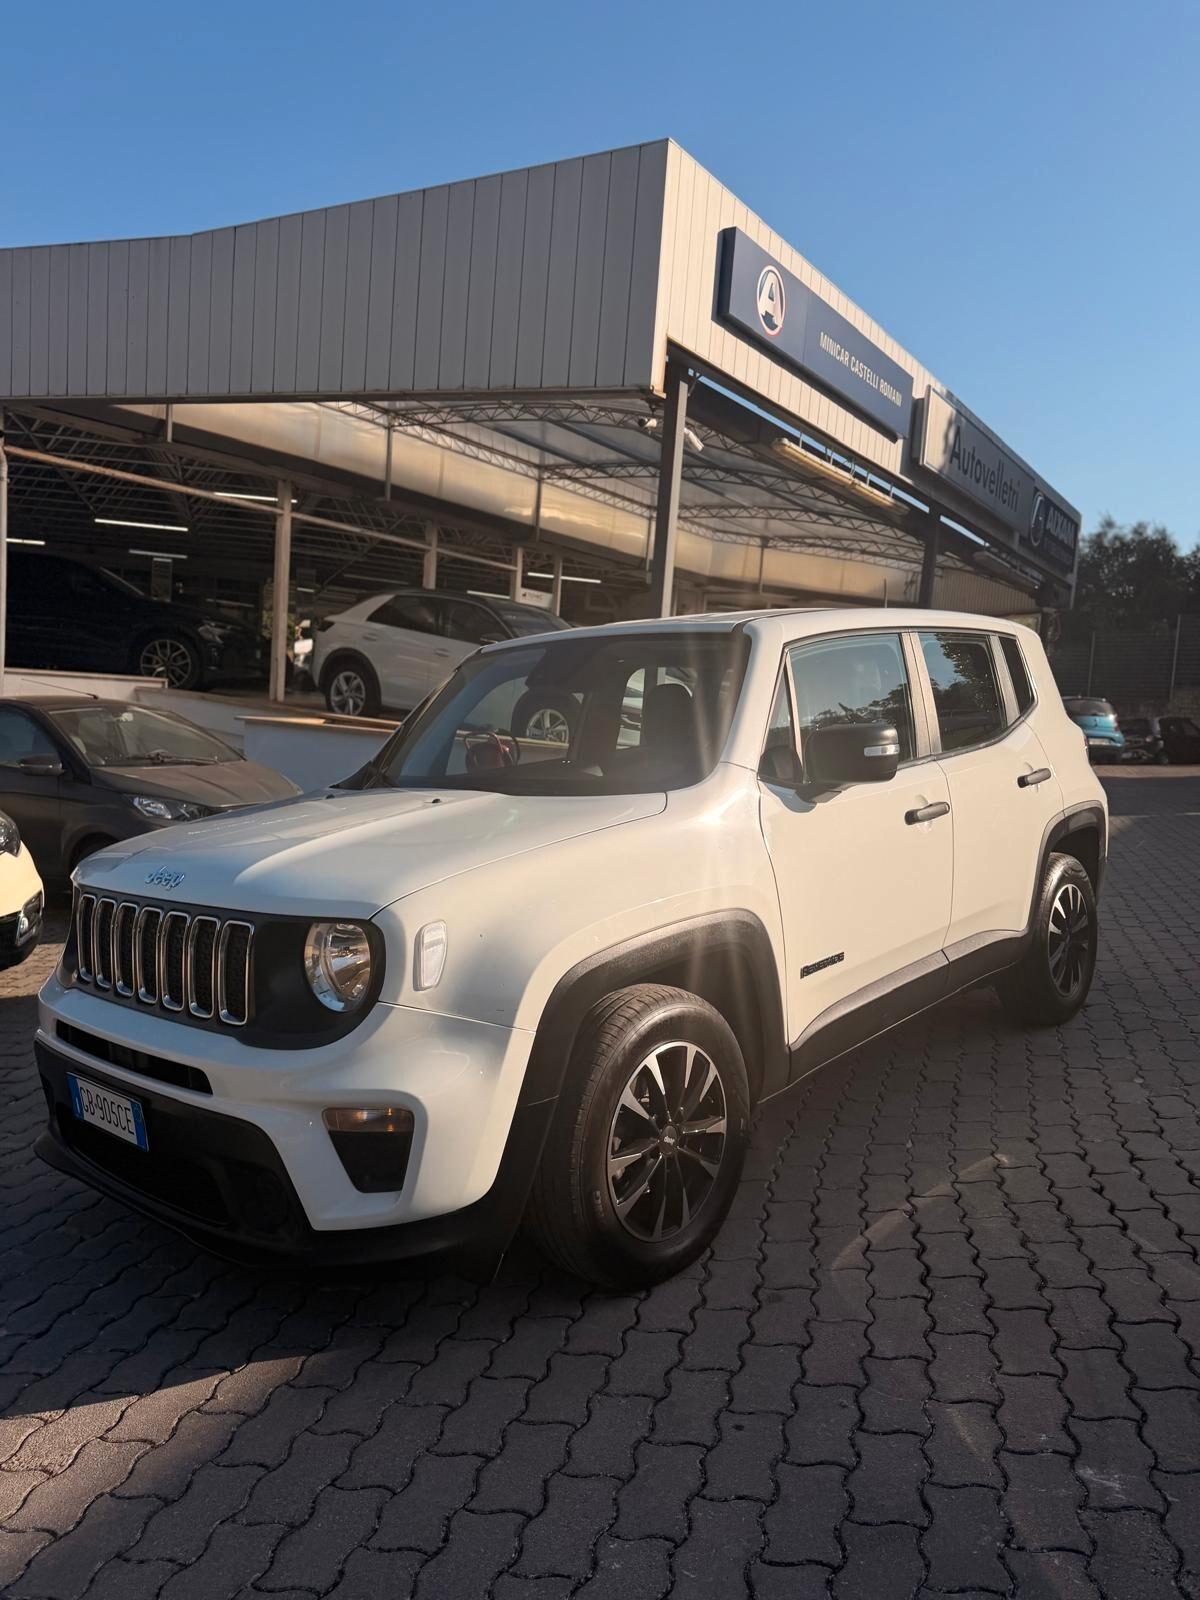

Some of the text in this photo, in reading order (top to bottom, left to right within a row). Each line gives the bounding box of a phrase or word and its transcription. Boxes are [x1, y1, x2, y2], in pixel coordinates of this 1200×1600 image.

[819, 331, 903, 407] MINICAR CASTELLI ROMANI
[948, 425, 1021, 513] Autovelletri
[144, 862, 185, 891] Jeep
